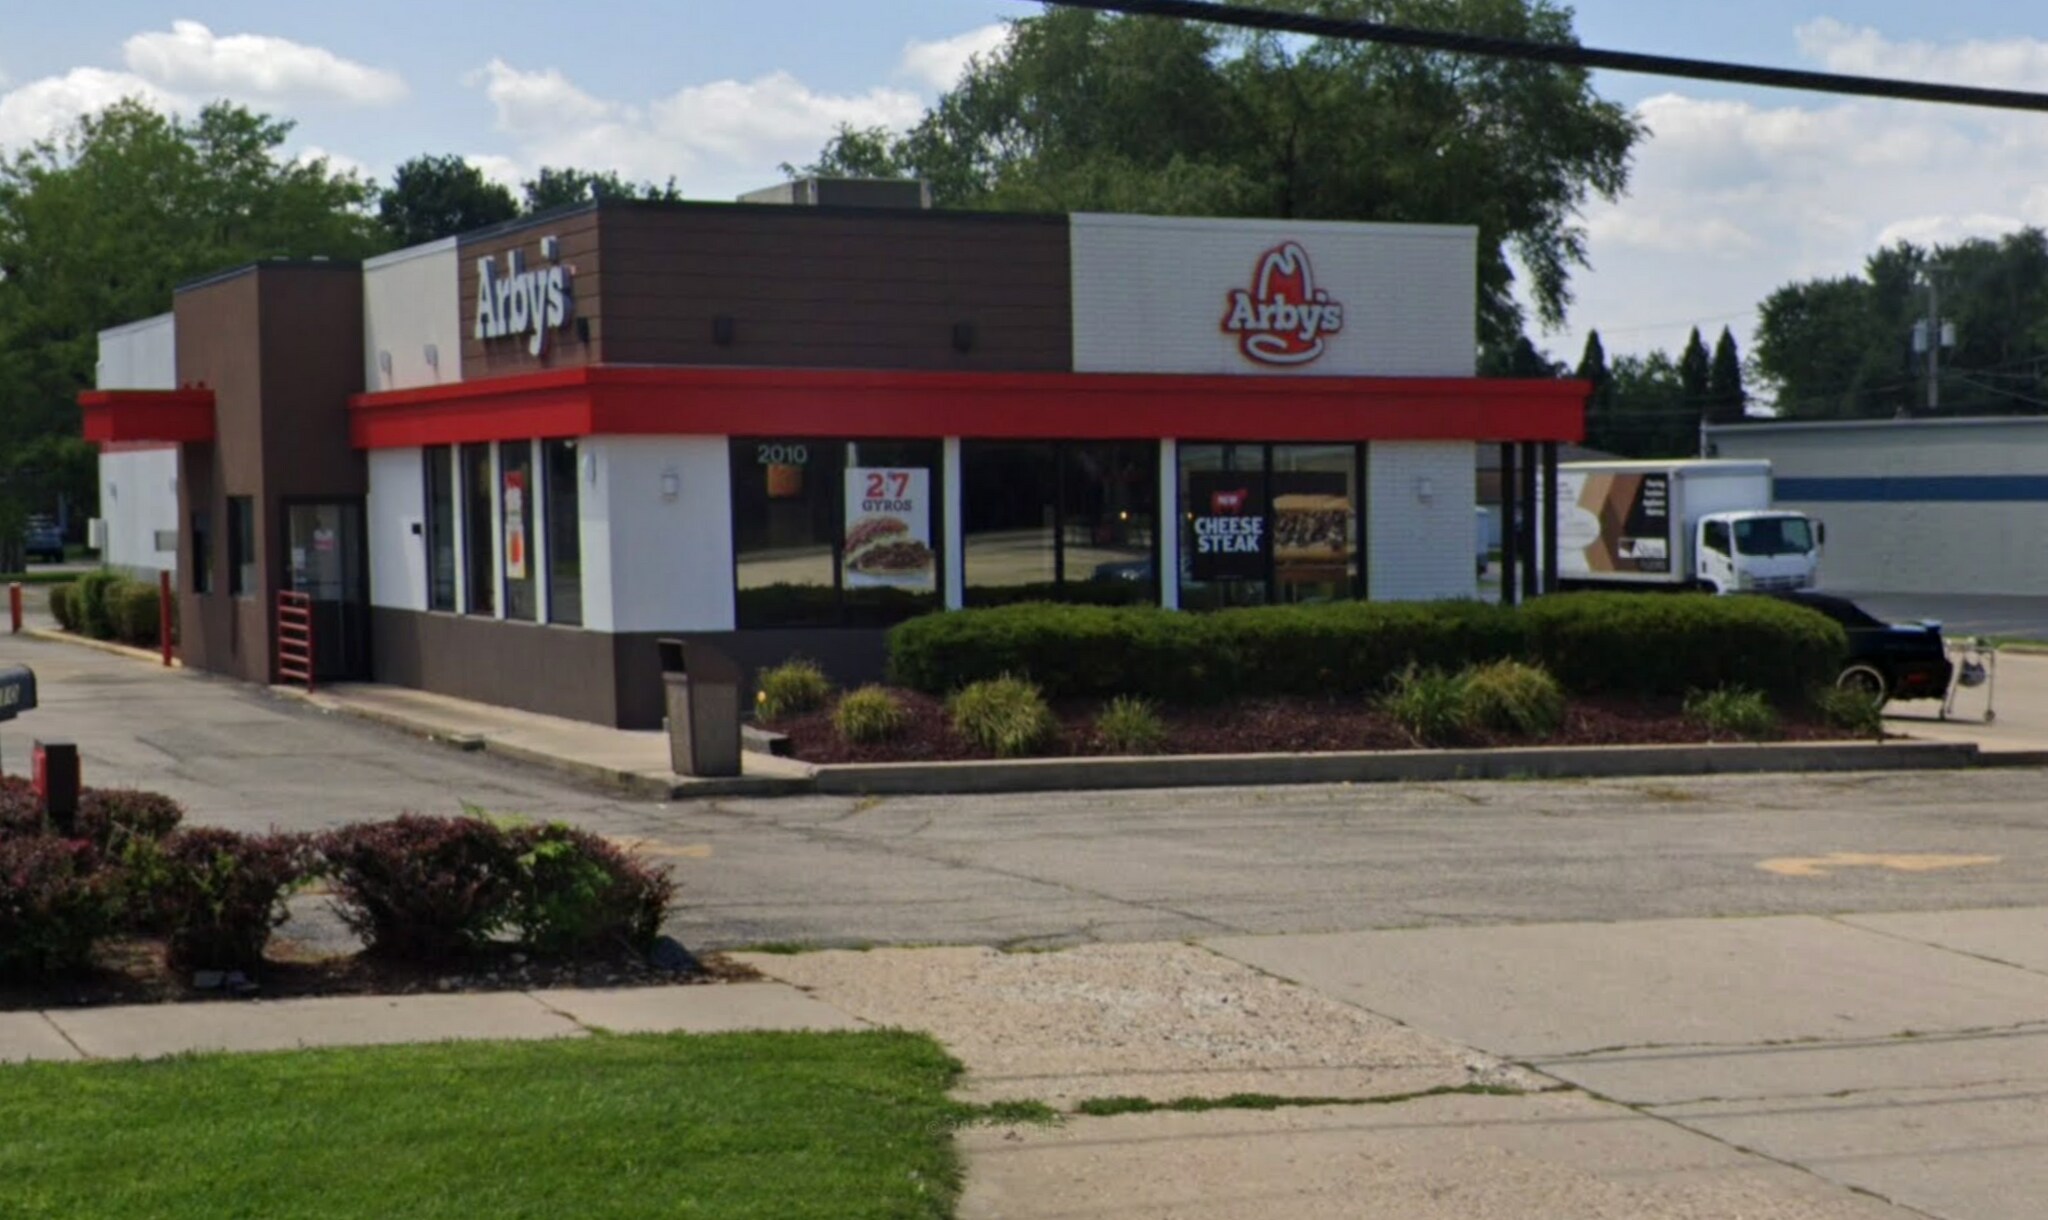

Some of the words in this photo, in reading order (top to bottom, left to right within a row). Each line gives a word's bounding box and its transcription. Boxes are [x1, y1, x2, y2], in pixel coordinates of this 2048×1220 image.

[475, 236, 568, 356] Arby's
[1227, 289, 1342, 341] Arby's
[757, 445, 808, 464] 2010
[862, 499, 912, 512] GYROS
[1194, 517, 1264, 534] CHEESE
[1198, 535, 1260, 553] STEAK
